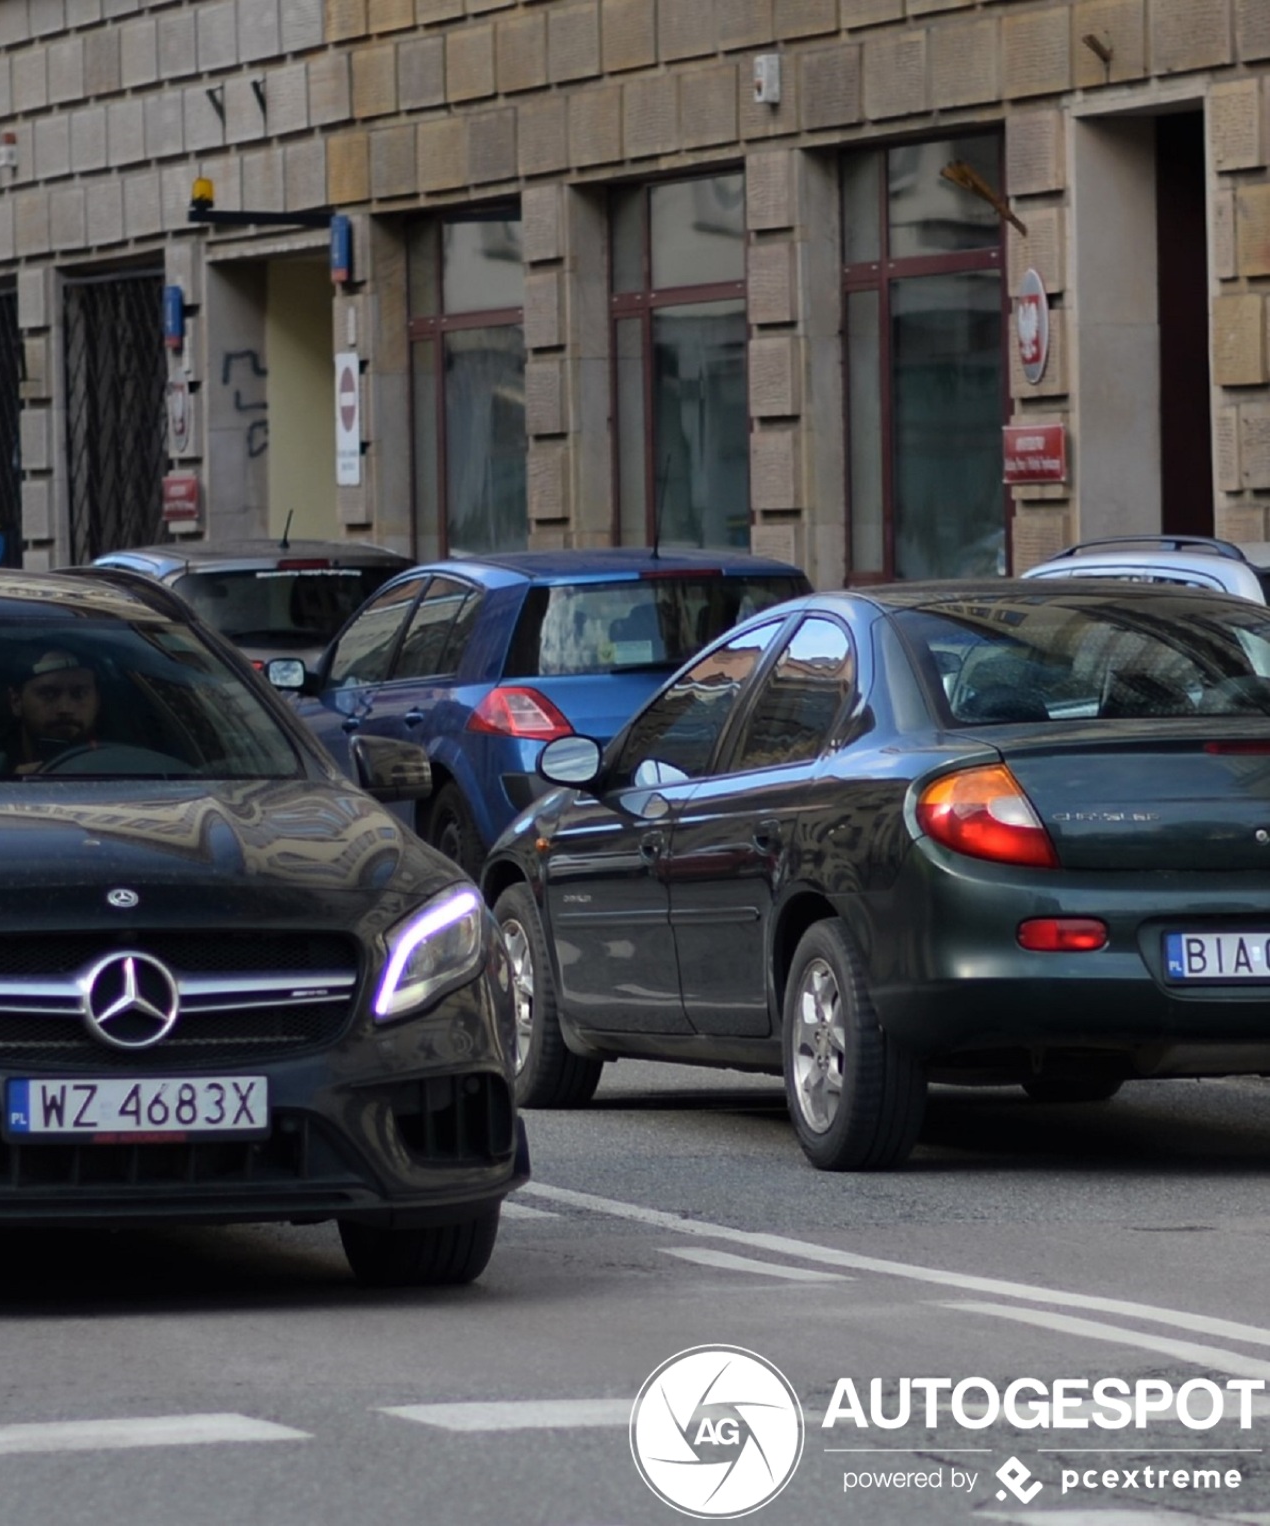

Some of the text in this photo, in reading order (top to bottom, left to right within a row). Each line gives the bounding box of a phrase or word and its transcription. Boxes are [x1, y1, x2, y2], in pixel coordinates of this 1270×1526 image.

[11, 1081, 256, 1128] PL WZ 4683X
